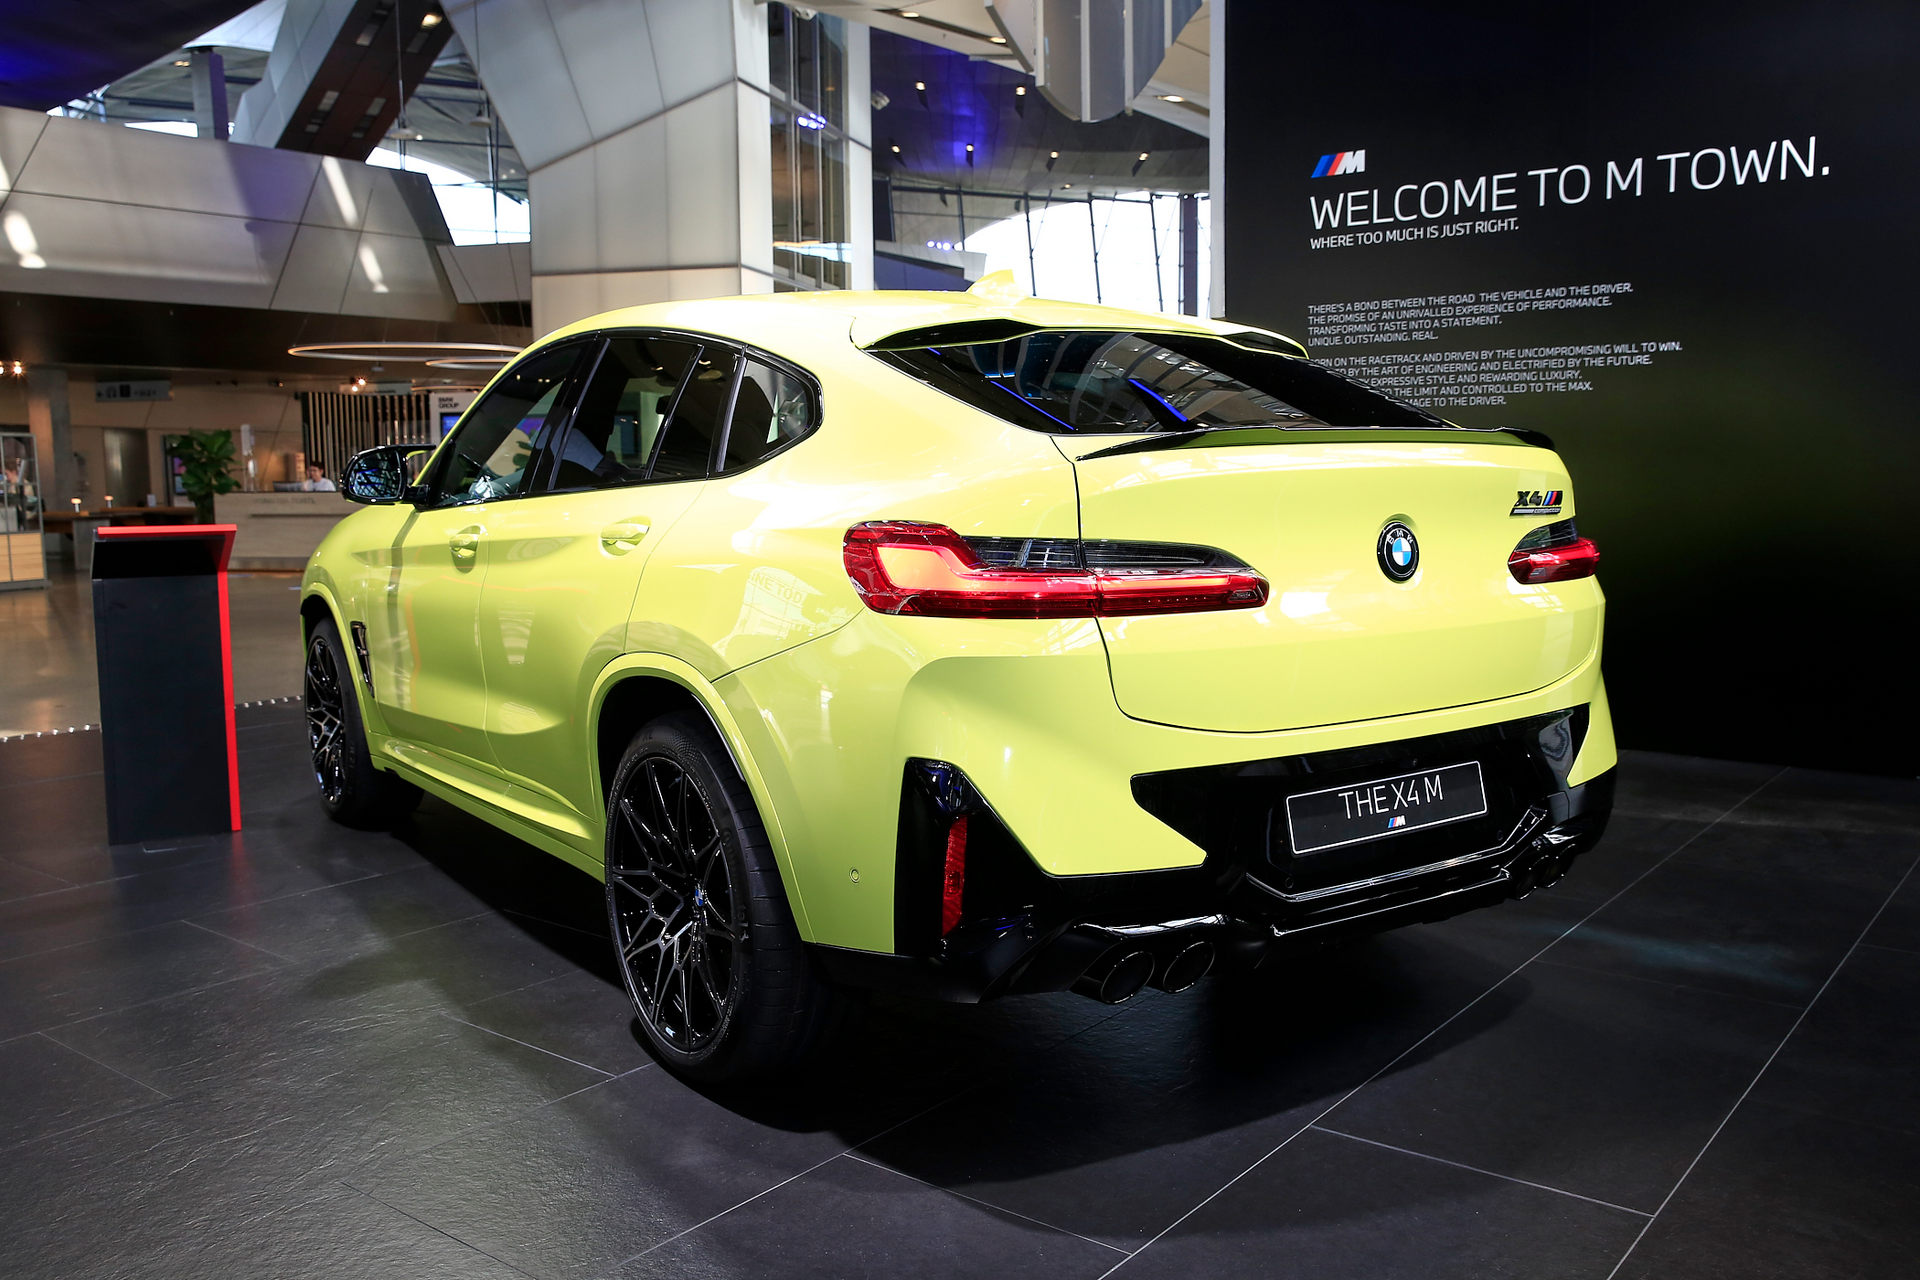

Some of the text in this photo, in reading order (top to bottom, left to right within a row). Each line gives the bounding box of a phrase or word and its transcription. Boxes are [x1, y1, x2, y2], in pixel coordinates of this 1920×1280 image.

[1310, 136, 1829, 229] WELCOME TO M TOWN.
[1310, 217, 1519, 249] WHERE TOO MUCH IS JUST RIGHT.
[1308, 282, 1634, 314] THERE'S A BOND BETWEEN THE ROAD THE VEHICLE AND THE DRIVER.
[1308, 296, 1613, 325] THE PROMISE OF AN UNRIVALLED EXPERIENCE OF PERFORMANCE.
[1308, 314, 1503, 336] TRANSFORMING TASTE INTO A STATEMENT.
[1344, 332, 1411, 345] OUTSTANDING.
[1412, 330, 1439, 341] REAL.
[1333, 356, 1347, 367] ON
[1348, 355, 1367, 366] THE
[1368, 353, 1421, 365] RACETRACK
[1422, 352, 1443, 362] AND
[1444, 350, 1479, 362] DRIVEN
[1480, 349, 1494, 360] BY
[1495, 348, 1517, 359] THE
[1517, 344, 1612, 358] UNCOMPROMISING
[1612, 343, 1639, 354] WILL
[1640, 342, 1657, 352] TO
[1658, 341, 1683, 352] WIN.
[1348, 367, 1360, 377] BY
[1361, 367, 1380, 376] THE
[1380, 365, 1399, 375] ART
[1400, 365, 1414, 375] OF
[1415, 362, 1478, 374] ENGINEERING
[1479, 360, 1501, 371] AND
[1502, 358, 1566, 370] ELECTRIFIED
[1567, 358, 1582, 368] BY
[1583, 356, 1605, 367] THE
[1606, 354, 1653, 366] FUTURE.
[1371, 374, 1425, 387] EXPRESSIVE
[1426, 374, 1456, 385] STYLE
[1456, 373, 1478, 384] AND
[1479, 371, 1538, 383] REWARDING
[1540, 369, 1582, 381] LUXURY.
[1393, 387, 1413, 397] THE
[1413, 386, 1439, 397] LIMIT
[1439, 385, 1460, 395] AND
[1461, 383, 1528, 395] CONTROLLED
[1528, 383, 1544, 393] TO
[1545, 381, 1567, 392] THE
[1568, 381, 1594, 391] MAX.
[1433, 397, 1447, 407] TO
[1448, 396, 1468, 406] THE
[1469, 395, 1507, 406] DRIVER.
[1514, 490, 1543, 506] X4
[1387, 529, 1414, 545] BMW
[1338, 774, 1444, 819] THE X4 M
